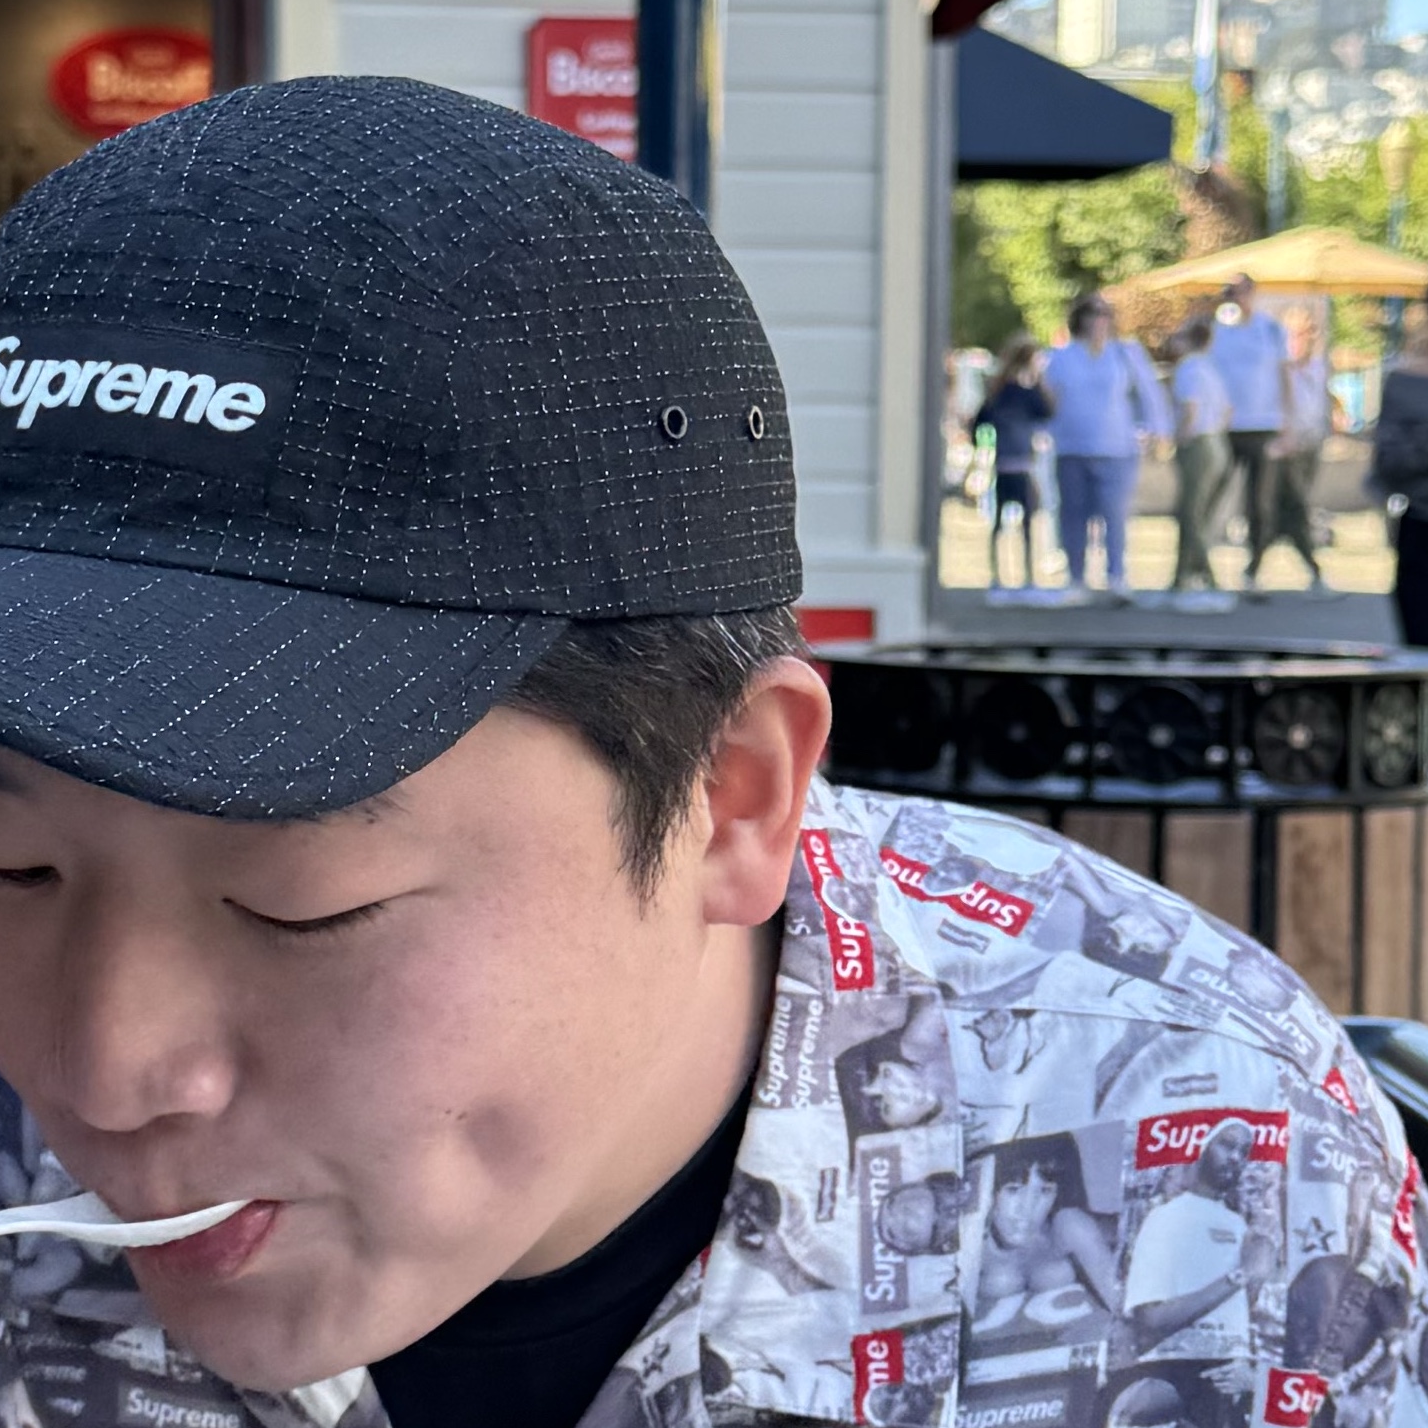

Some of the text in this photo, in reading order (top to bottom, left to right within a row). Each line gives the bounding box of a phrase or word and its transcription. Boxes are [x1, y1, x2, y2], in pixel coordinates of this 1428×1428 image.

[808, 835, 864, 979] Supme
[883, 859, 1021, 928] Supme
[1147, 1118, 1288, 1157] Supme
[865, 1156, 905, 1302] Supme
